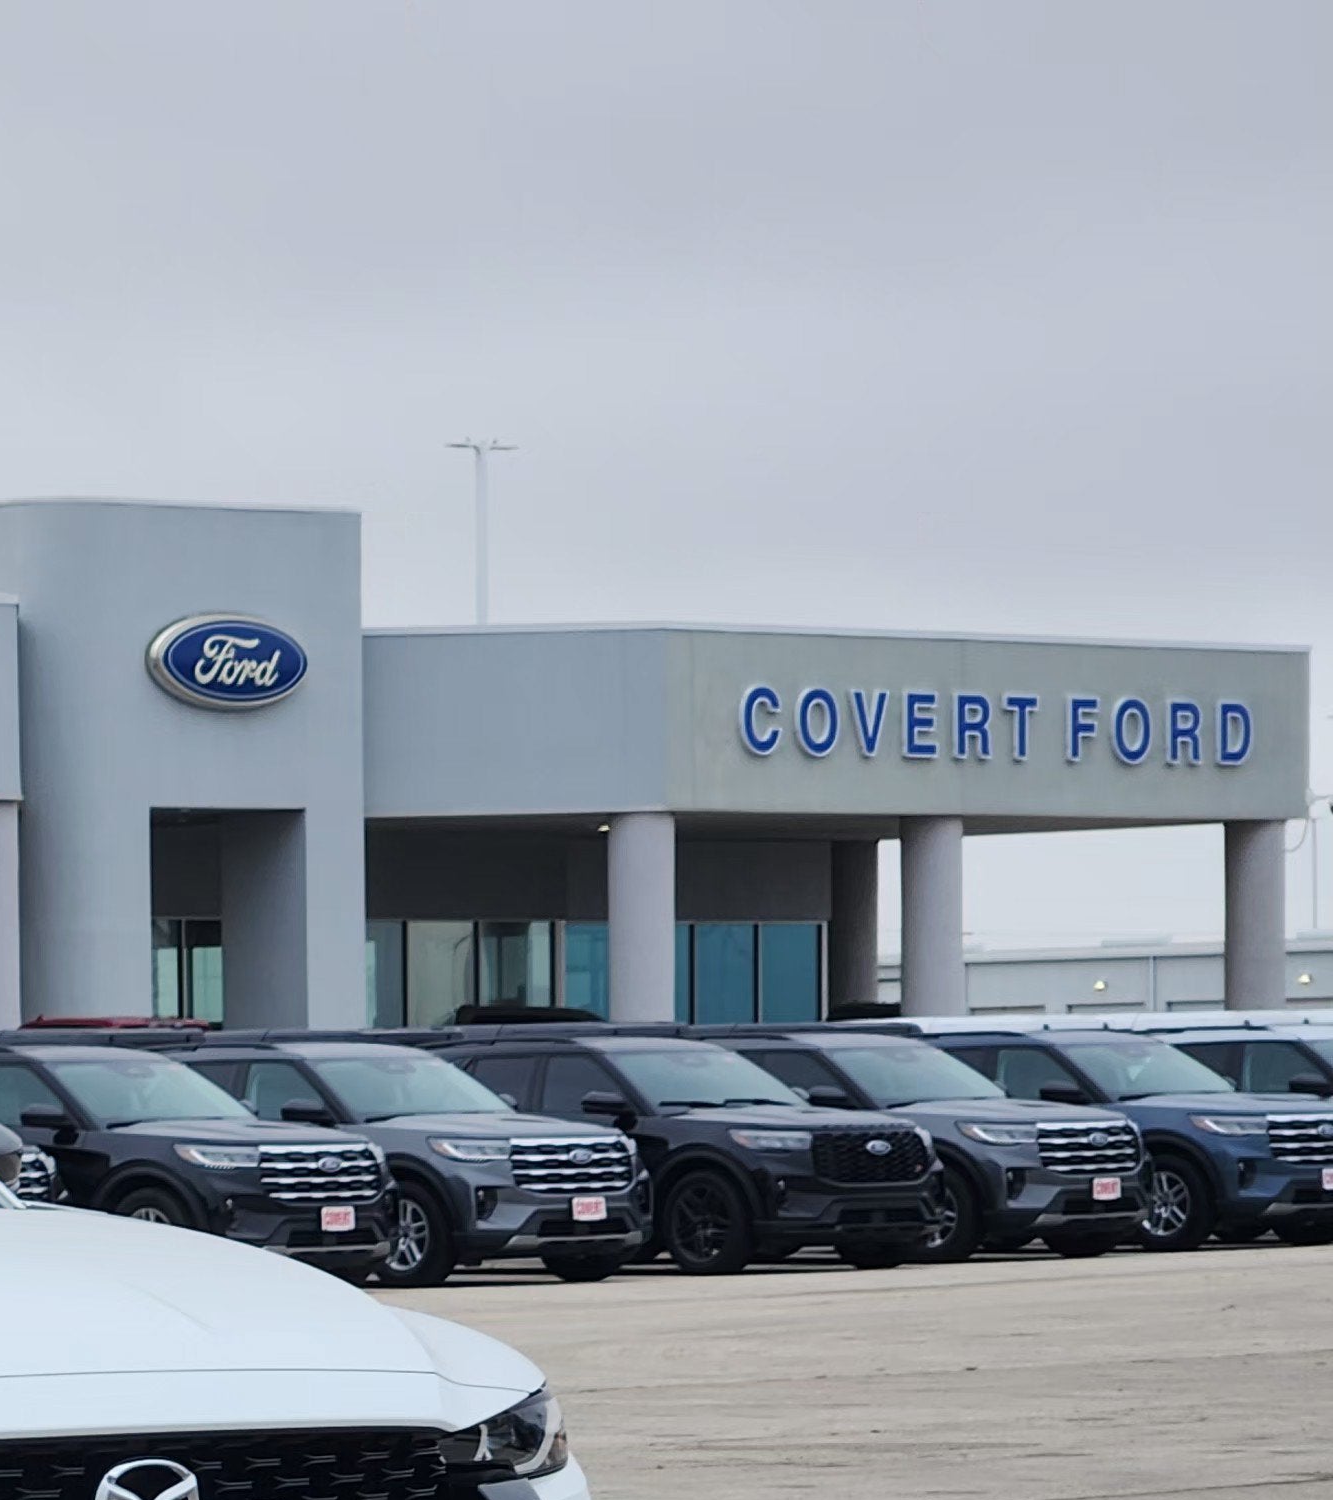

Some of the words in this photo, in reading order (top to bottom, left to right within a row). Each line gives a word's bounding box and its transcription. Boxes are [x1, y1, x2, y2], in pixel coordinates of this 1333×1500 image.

[194, 634, 281, 687] Ford
[740, 686, 1039, 761] COVERT
[1065, 695, 1254, 766] FORD
